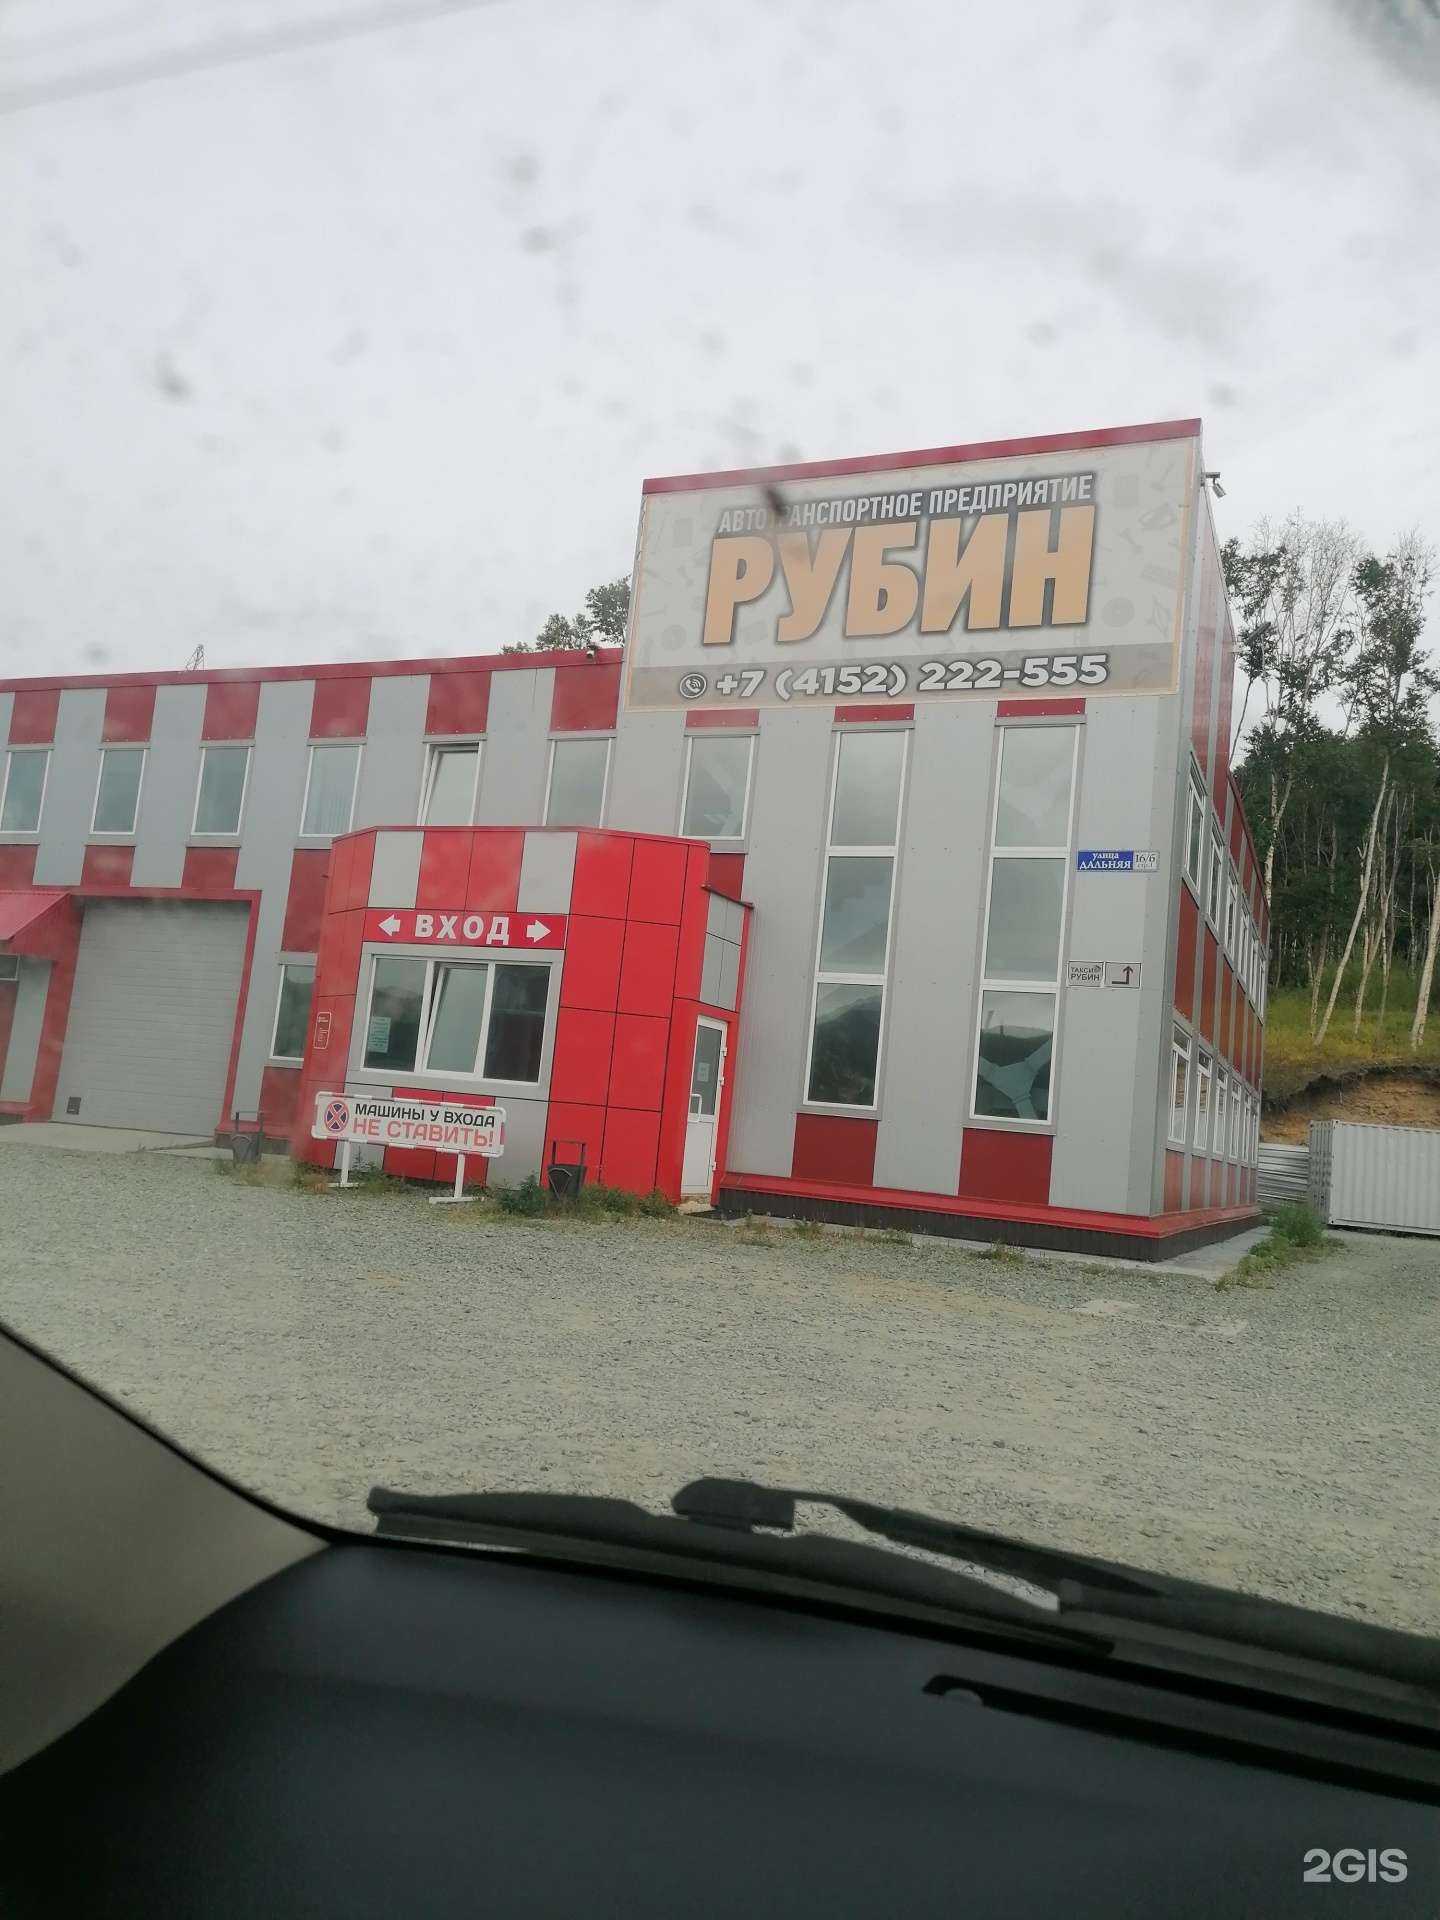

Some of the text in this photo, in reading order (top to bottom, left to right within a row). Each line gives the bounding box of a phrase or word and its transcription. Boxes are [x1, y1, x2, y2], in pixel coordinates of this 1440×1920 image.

[718, 474, 1093, 534] АВТОАНСПОРТНОЕ ПРЕДПРИЯТИЕ
[702, 505, 1096, 645] РУБИН
[716, 654, 1108, 701] +7 (4152) 222-555
[1079, 860, 1131, 870] ДАЛЬНЯЯ
[414, 914, 510, 945] ВХОД
[1070, 973, 1100, 981] РУБИН
[355, 1103, 495, 1128] МАШИНЫ У ВХОДА
[352, 1118, 494, 1148] НЕ СТАВИТЬ!
